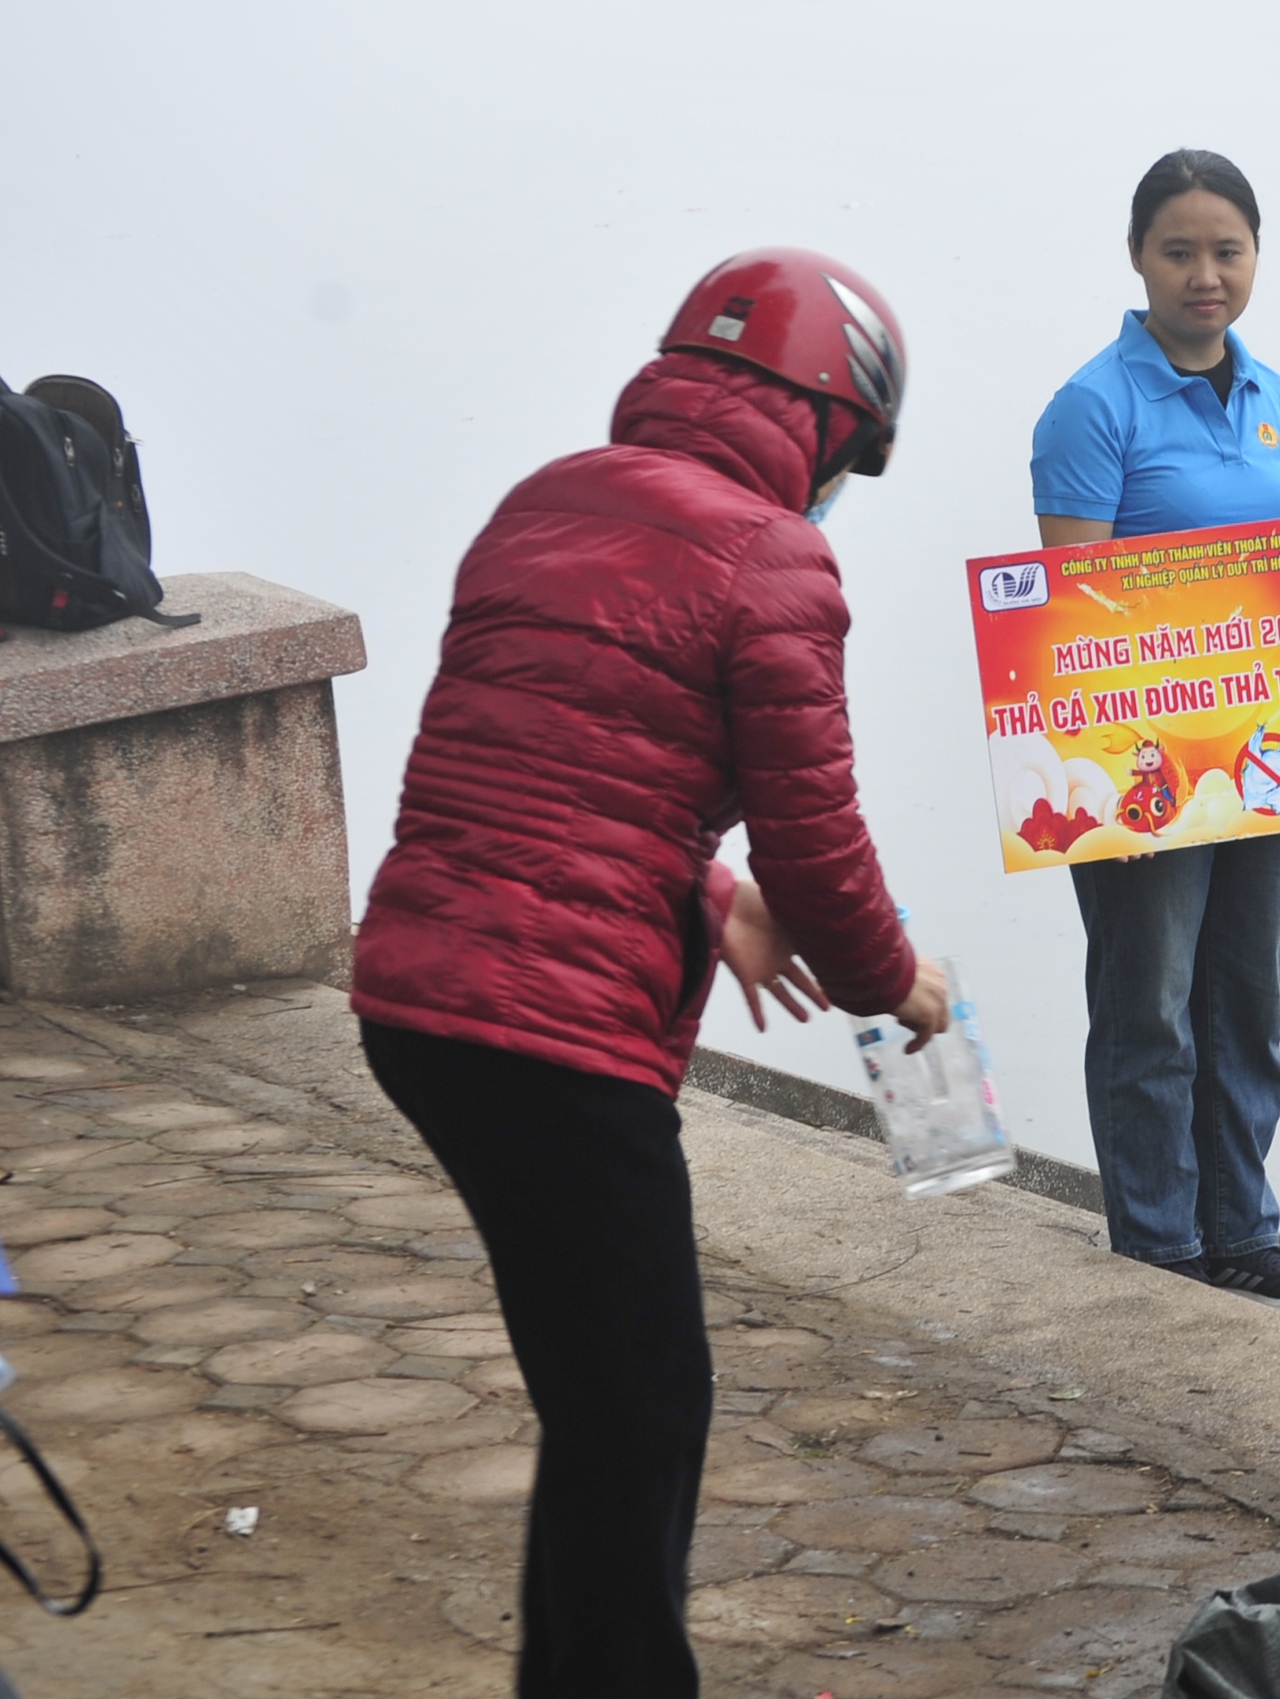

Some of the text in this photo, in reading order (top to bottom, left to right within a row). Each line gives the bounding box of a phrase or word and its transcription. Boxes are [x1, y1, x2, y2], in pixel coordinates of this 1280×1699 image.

[1061, 558, 1093, 577] CÔNG
[1095, 557, 1108, 572] TY
[1110, 553, 1140, 570] TNHH
[1141, 548, 1165, 568] MỘT
[1168, 544, 1205, 563] THÀNH
[1206, 540, 1232, 558] VIÊN
[1234, 535, 1268, 555] THOÁT
[1122, 573, 1134, 591] XÍ
[1136, 568, 1176, 588] NGHIỆP
[1179, 562, 1210, 583] QUẢN
[1211, 561, 1224, 579] LÝ
[1227, 561, 1248, 577] DUY
[1251, 555, 1269, 574] TRÌ
[1054, 634, 1132, 675] MỪNG
[1138, 624, 1197, 663] NĂM
[1204, 615, 1253, 654] MỚI
[993, 691, 1047, 738] THẢ
[1051, 689, 1089, 731] CÁ
[1093, 689, 1139, 725] XIN
[1144, 677, 1216, 717] ĐỪNG
[1220, 660, 1272, 706] THẢ
